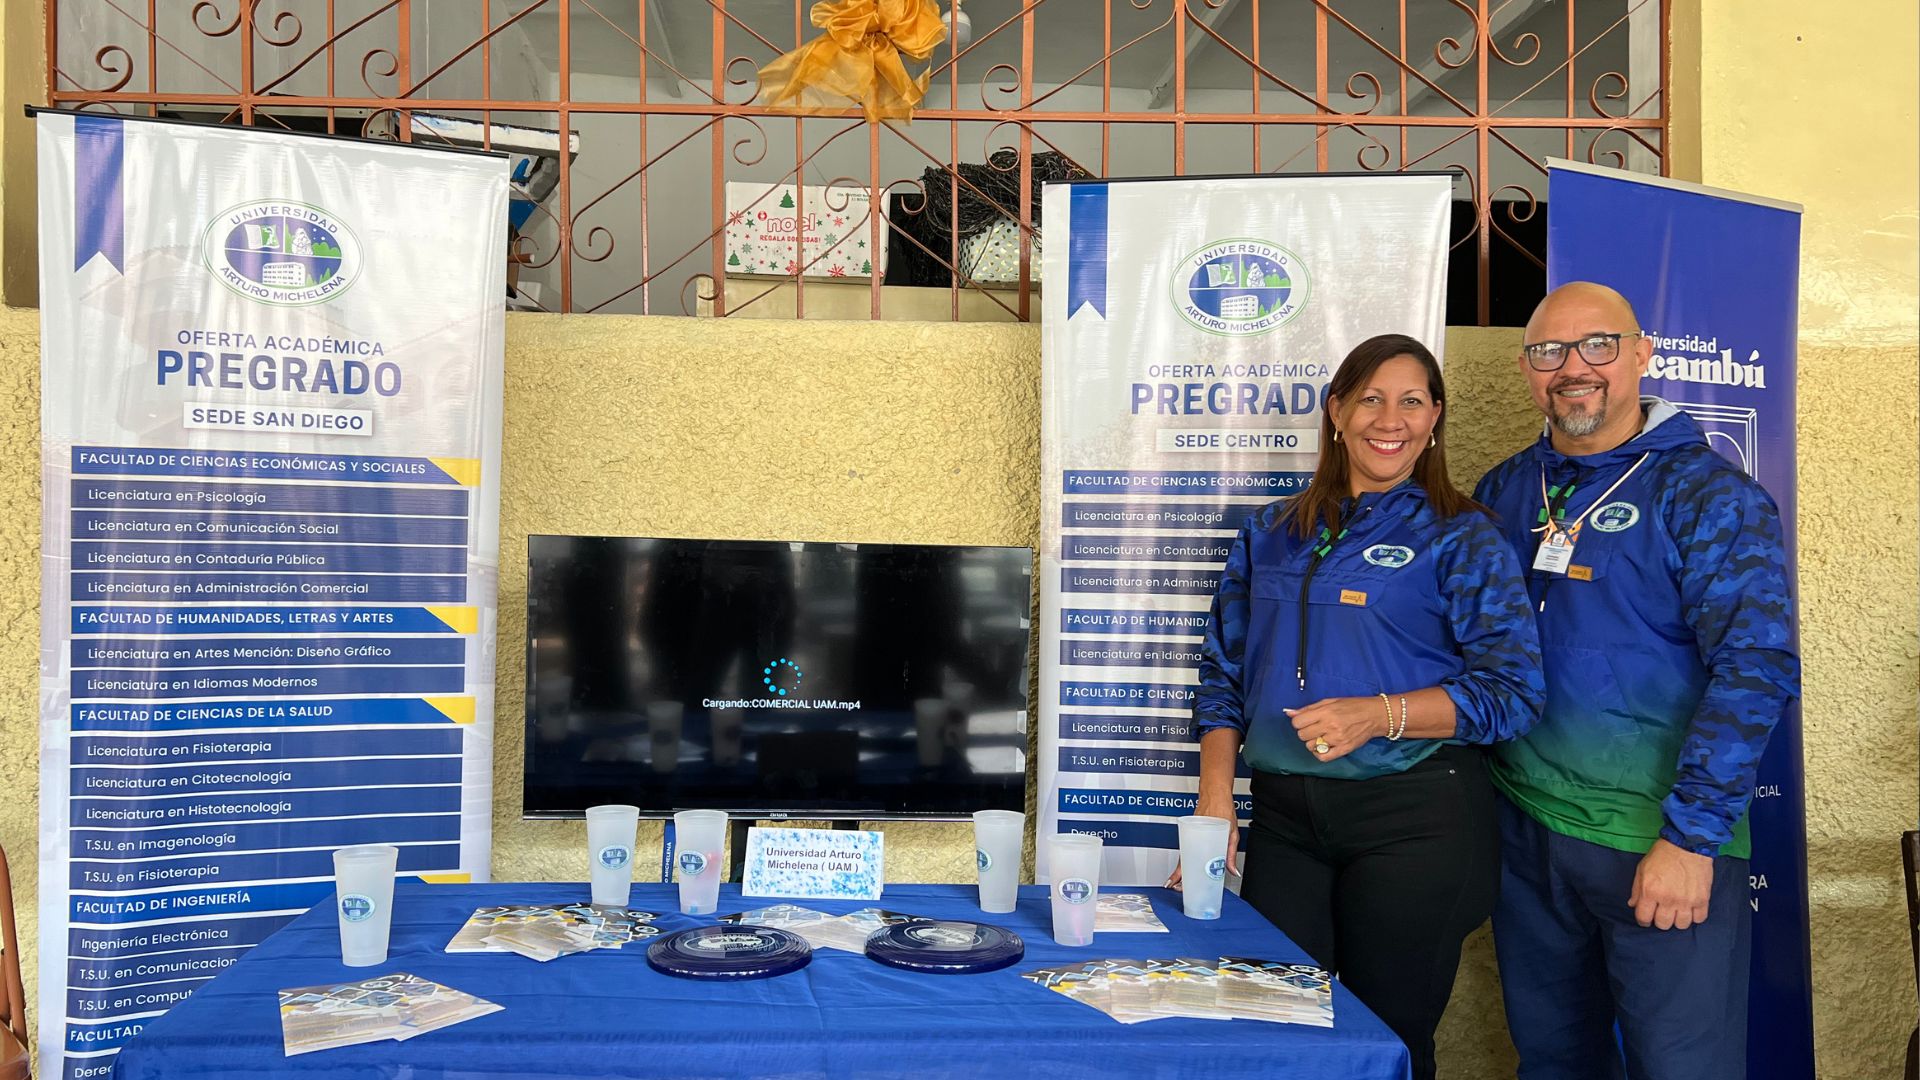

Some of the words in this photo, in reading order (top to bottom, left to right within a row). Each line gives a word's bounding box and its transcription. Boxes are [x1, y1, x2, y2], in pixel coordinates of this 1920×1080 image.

[231, 206, 338, 234] UNIVERSIDAD
[767, 212, 815, 232] noel
[1194, 244, 1288, 267] UNIVERSIDAD
[220, 267, 269, 297] ARTURO
[273, 275, 346, 301] MICHELENA
[1185, 306, 1227, 330] ARTURO
[1230, 303, 1294, 332] MICHELENA
[178, 330, 257, 349] OFERTA
[264, 336, 385, 356] ACADÉMICA
[1641, 331, 1717, 353] iversidad
[157, 350, 402, 396] PREGRADO
[1149, 365, 1216, 378] OFERTA
[1222, 361, 1329, 377] ACADÉMICA
[1642, 349, 1766, 389] cambú
[192, 409, 245, 425] SEDE
[253, 411, 295, 427] SAN
[302, 413, 364, 430] DIEGO
[1175, 434, 1219, 448] SEDE
[1226, 434, 1298, 448] CENTRO
[80, 453, 155, 466] FACULTAD
[159, 456, 175, 466] DE
[180, 456, 247, 468] CIENCIAS
[252, 458, 346, 472] ECONÓMICAS
[351, 462, 359, 471] Y
[362, 462, 426, 474] SOCIALES
[1070, 476, 1130, 486] FACULTAD
[1134, 476, 1147, 486] DE
[1152, 476, 1207, 487] CIENCIAS
[1211, 475, 1293, 488] ECONÓMICAS
[1298, 478, 1304, 487] Y
[88, 490, 172, 501] Licenciatura
[176, 492, 193, 501] en
[198, 491, 266, 505] Psicología
[1076, 511, 1144, 521] Licenciatura
[1148, 513, 1161, 521] en
[1165, 512, 1222, 525] Psicología
[88, 520, 171, 532] Licenciatura
[175, 523, 192, 532] en
[196, 522, 295, 534] Comunicación
[300, 524, 339, 534] Social
[1075, 545, 1143, 555] Licenciatura
[1146, 547, 1160, 555] en
[1164, 546, 1229, 556] Contaduría
[88, 552, 170, 564] Licenciatura
[175, 555, 191, 564] en
[196, 553, 273, 565] Contaduría
[277, 554, 325, 565] Pública
[88, 582, 170, 593] Licenciatura
[174, 584, 191, 593] en
[196, 582, 297, 594] Administración
[301, 583, 369, 594] Comercial
[1074, 577, 1143, 587] Licenciatura
[1146, 579, 1159, 587] en
[80, 612, 151, 624] FACULTAD
[156, 614, 173, 624] DE
[178, 613, 284, 625] HUMANIDADES,
[289, 613, 337, 623] LETRAS
[341, 613, 349, 623] Y
[353, 613, 394, 623] ARTES
[1067, 615, 1127, 626] FACULTAD
[1131, 616, 1145, 625] DE
[88, 648, 169, 660] Licenciatura
[174, 650, 191, 659] en
[195, 648, 230, 658] Artes
[234, 647, 293, 658] Mención:
[297, 647, 341, 658] Diseño
[344, 646, 391, 657] Gráfico
[1073, 649, 1141, 659] Licenciatura
[1145, 651, 1158, 659] en
[88, 679, 168, 691] Licenciatura
[172, 681, 190, 690] en
[194, 678, 248, 689] Idiomas
[252, 677, 318, 688] Modernos
[1066, 688, 1126, 698] FACULTAD
[1130, 689, 1143, 698] DE
[703, 699, 811, 710] Cargando:COMERCIAL
[814, 700, 861, 711] UAM.mp4
[79, 710, 149, 722] FACULTAD
[154, 710, 171, 721] DE
[176, 708, 243, 720] CIENCIAS
[248, 707, 265, 718] DE
[269, 707, 285, 717] LA
[290, 706, 333, 717] SALUD
[1072, 723, 1141, 734] Licenciatura
[1144, 725, 1158, 734] en
[87, 744, 168, 757] Licenciatura
[172, 746, 189, 755] en
[193, 741, 272, 755] Fisioterapia
[1072, 756, 1099, 766] T.S.U.
[1102, 757, 1116, 766] en
[1120, 757, 1185, 770] Fisioterapia
[87, 776, 166, 789] Licenciatura
[171, 777, 188, 787] en
[192, 771, 292, 785] Citotecnología
[1065, 795, 1124, 806] FACULTAD
[1129, 796, 1142, 806] DE
[86, 808, 164, 821] Licenciatura
[168, 808, 185, 818] en
[189, 802, 292, 816] Histotecnología
[85, 840, 114, 851] T.S.U.
[118, 842, 135, 852] en
[139, 833, 235, 850] Imagenología
[664, 842, 672, 877] MICHELENA
[766, 847, 826, 859] Universidad
[829, 849, 862, 860] Arturo
[768, 860, 818, 871] Michelena
[829, 862, 852, 872] UAM
[84, 871, 113, 883] T.S.U.
[117, 873, 134, 883] en
[139, 865, 219, 881] Fisioterapia
[77, 901, 145, 914] FACULTAD
[150, 898, 168, 910] DE
[173, 891, 250, 908] INGENIERÍA
[82, 936, 148, 952] Ingeniería
[152, 929, 228, 945] Electrónica
[80, 969, 111, 980] T.S.U.
[115, 969, 132, 979] en
[78, 1000, 110, 1011] T.S.U.
[114, 998, 132, 1008] en
[70, 1025, 143, 1042] FACULTAD
